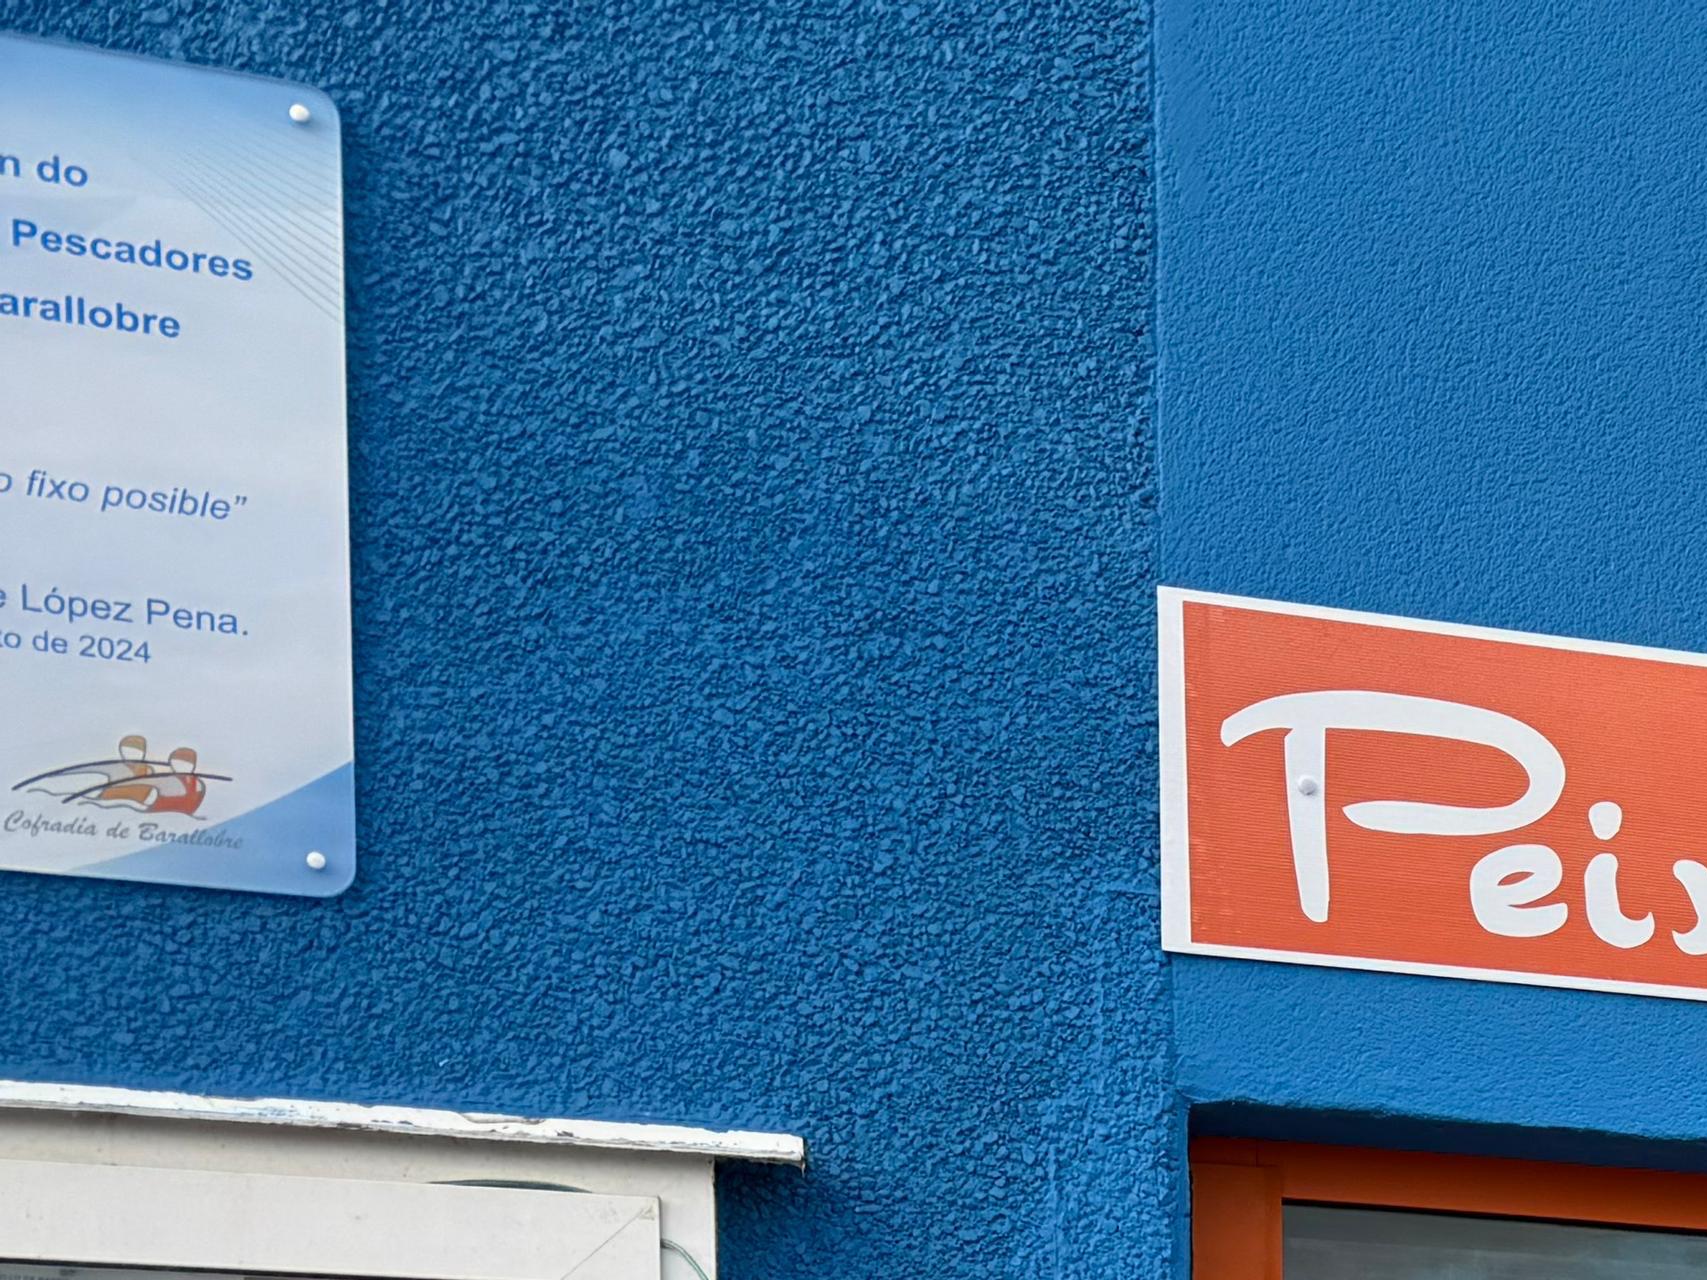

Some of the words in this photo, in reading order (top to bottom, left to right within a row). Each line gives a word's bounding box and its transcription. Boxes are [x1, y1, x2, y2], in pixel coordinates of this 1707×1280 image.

[36, 155, 89, 188] do
[12, 218, 254, 281] Pescadores
[0, 293, 181, 338] arallobre
[26, 469, 90, 503] fixo
[21, 583, 134, 623] López
[146, 598, 249, 636] Pena.
[32, 630, 68, 654] de
[78, 634, 152, 663] 2024
[106, 822, 129, 839] de
[138, 822, 244, 849] Barallobre
